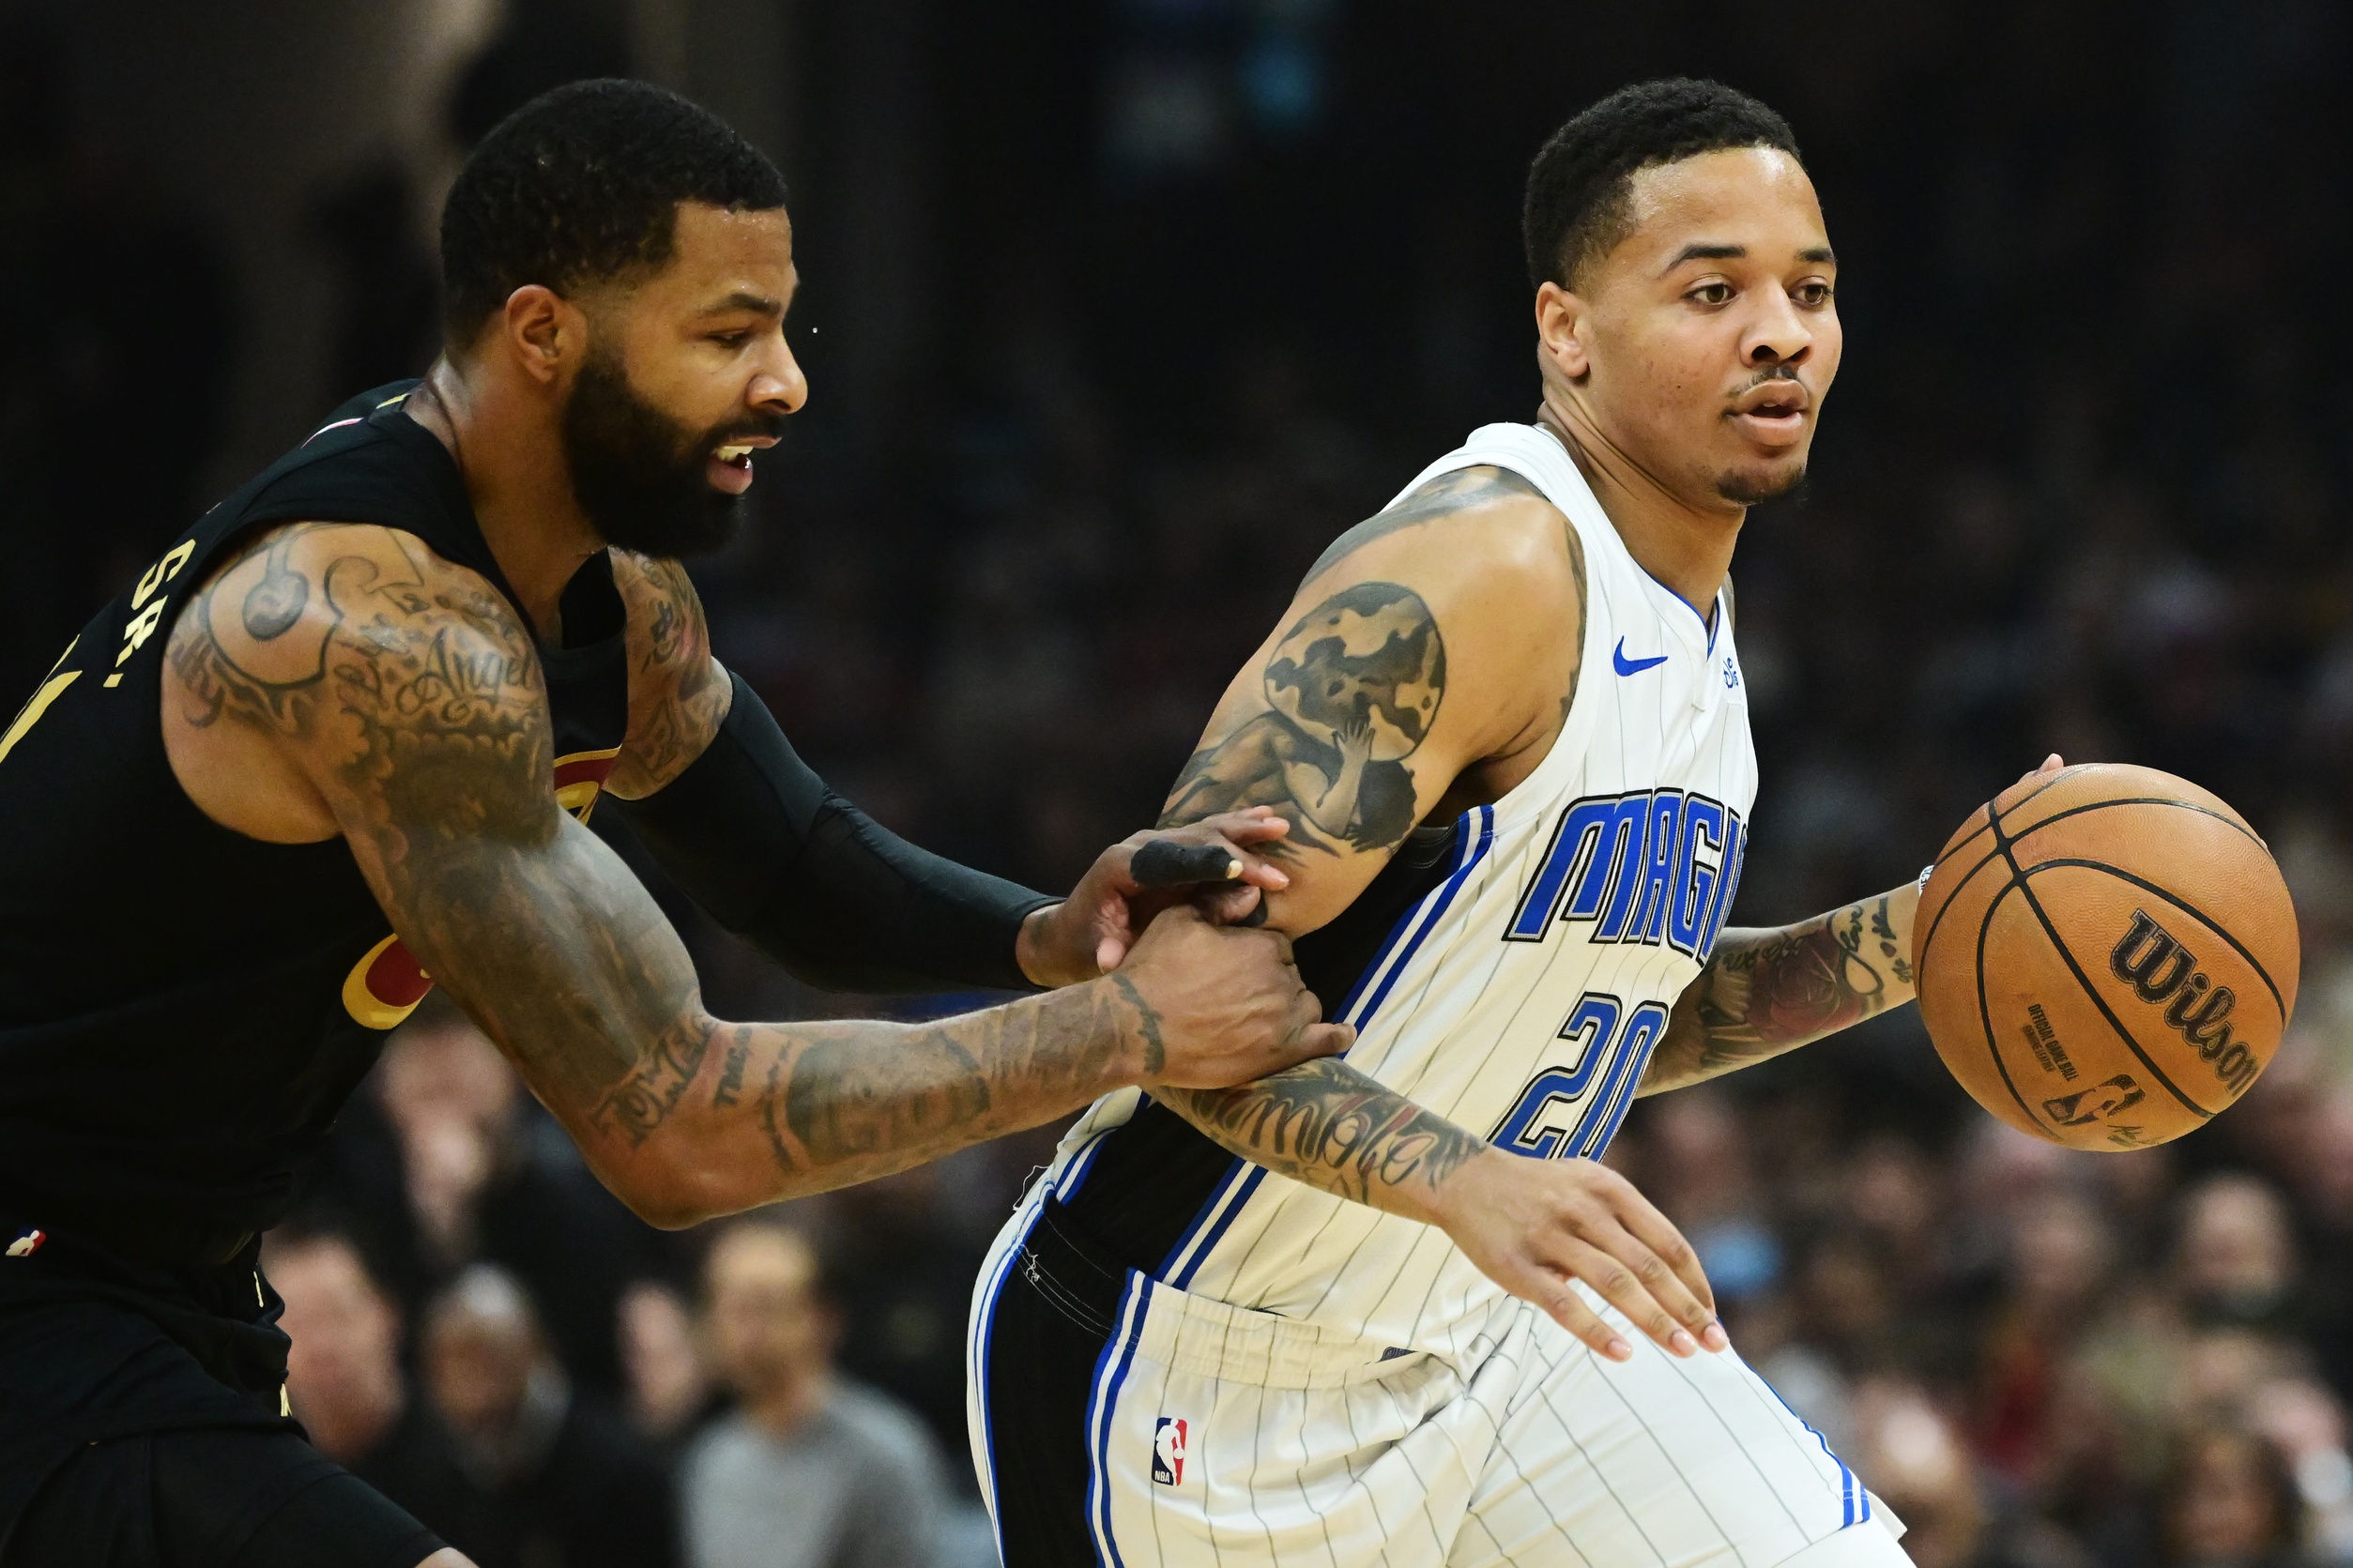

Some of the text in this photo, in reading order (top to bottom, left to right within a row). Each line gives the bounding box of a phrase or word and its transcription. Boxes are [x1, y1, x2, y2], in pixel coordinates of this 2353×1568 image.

[2027, 1004, 2080, 1082] OFFICIAL GAME BALL
[2110, 906, 2260, 1098] Wilson
[1486, 991, 1669, 1165] 20
[1155, 1470, 1170, 1483] NBA
